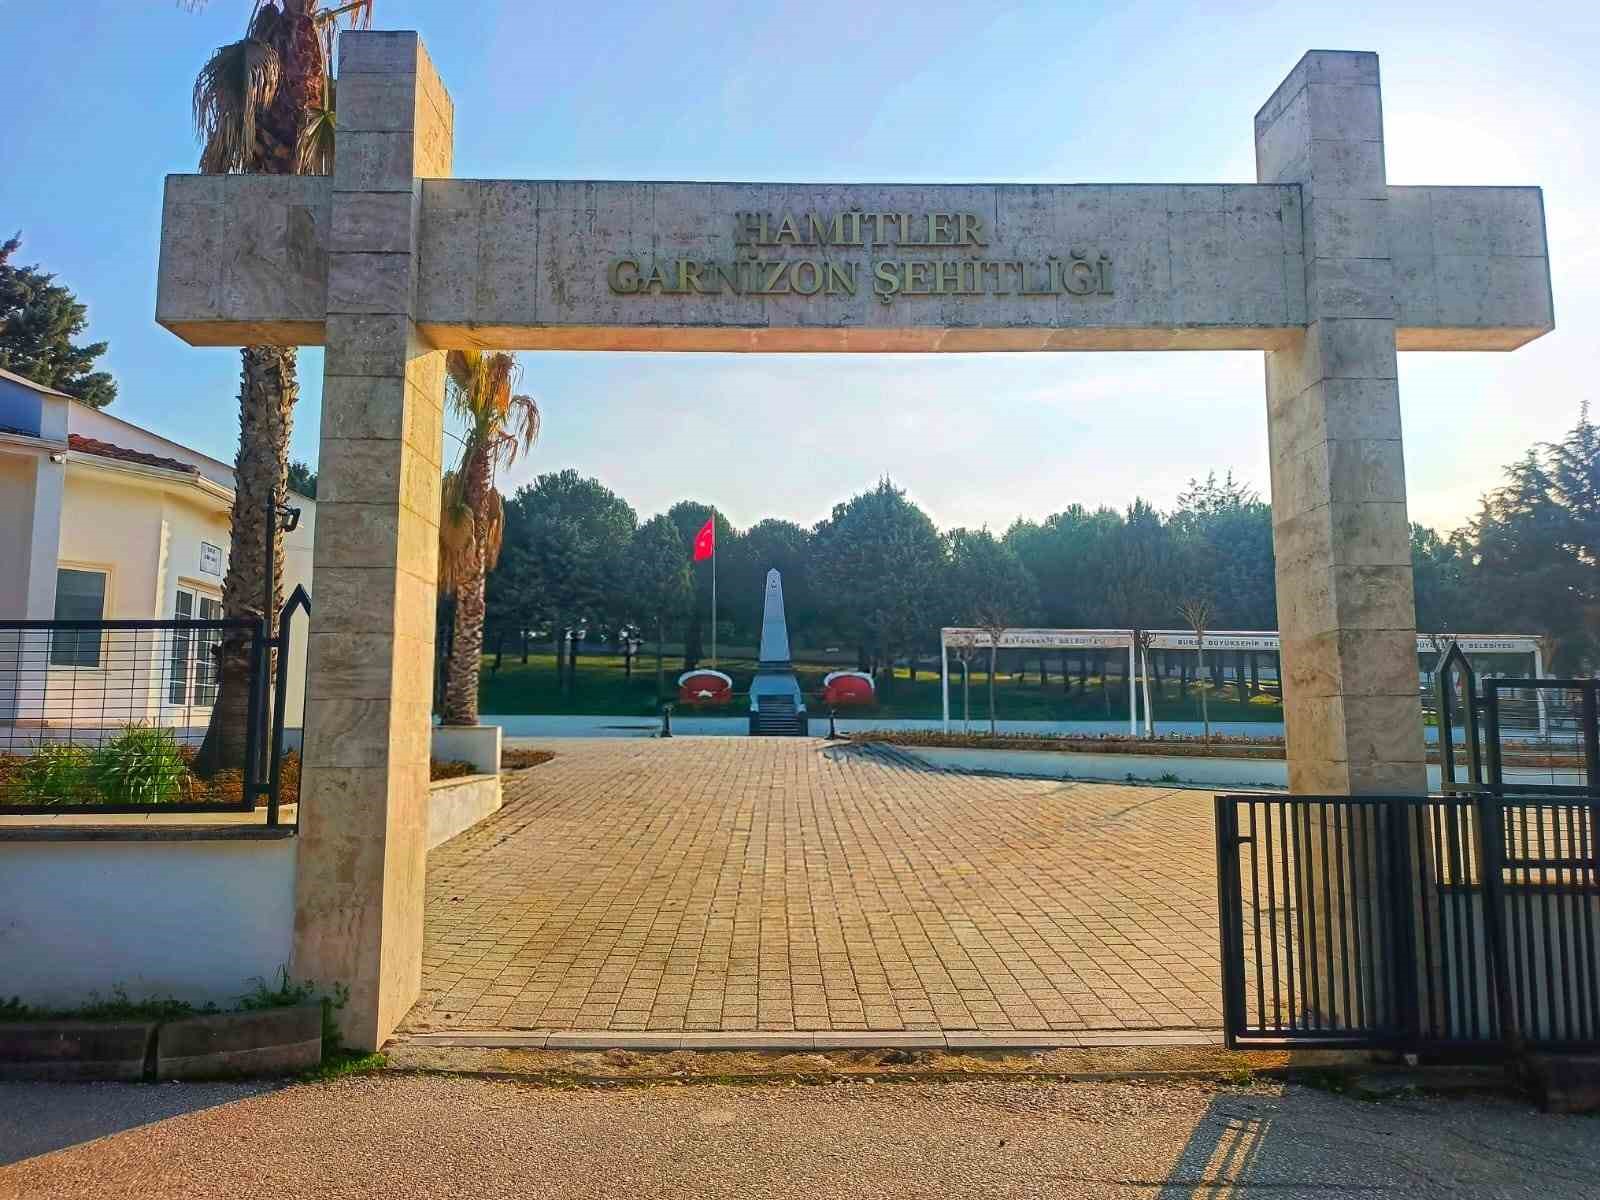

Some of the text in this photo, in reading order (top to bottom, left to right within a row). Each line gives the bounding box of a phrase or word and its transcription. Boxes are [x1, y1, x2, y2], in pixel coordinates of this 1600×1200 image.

[735, 207, 989, 247] HAMİTLER
[608, 249, 1114, 304] GARNİZON ŞEHİTLİĞİ
